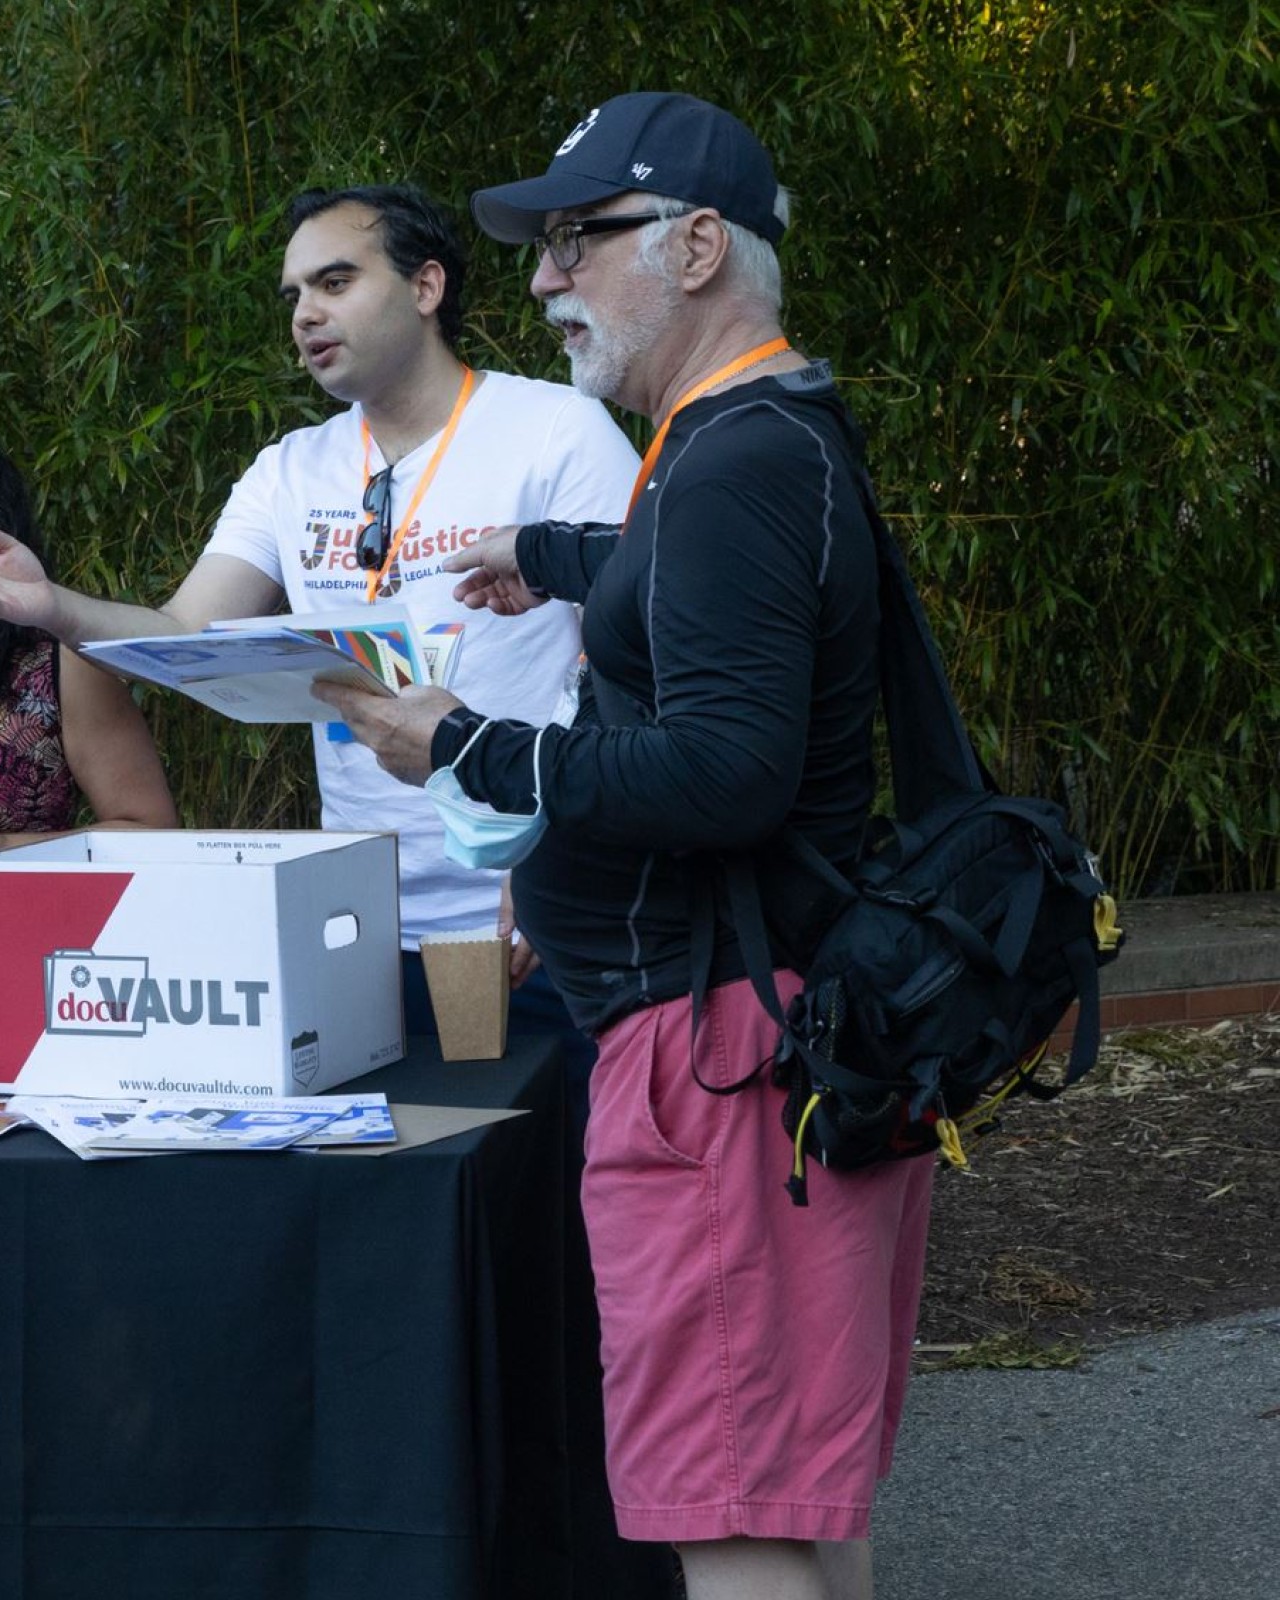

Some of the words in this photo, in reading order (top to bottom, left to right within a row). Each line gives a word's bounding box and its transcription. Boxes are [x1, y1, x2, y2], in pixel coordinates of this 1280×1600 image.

[309, 509, 323, 518] 25
[325, 509, 357, 520] YEARS
[404, 567, 433, 582] LEGAL
[118, 1077, 274, 1096] www.docuvaultdv.com
